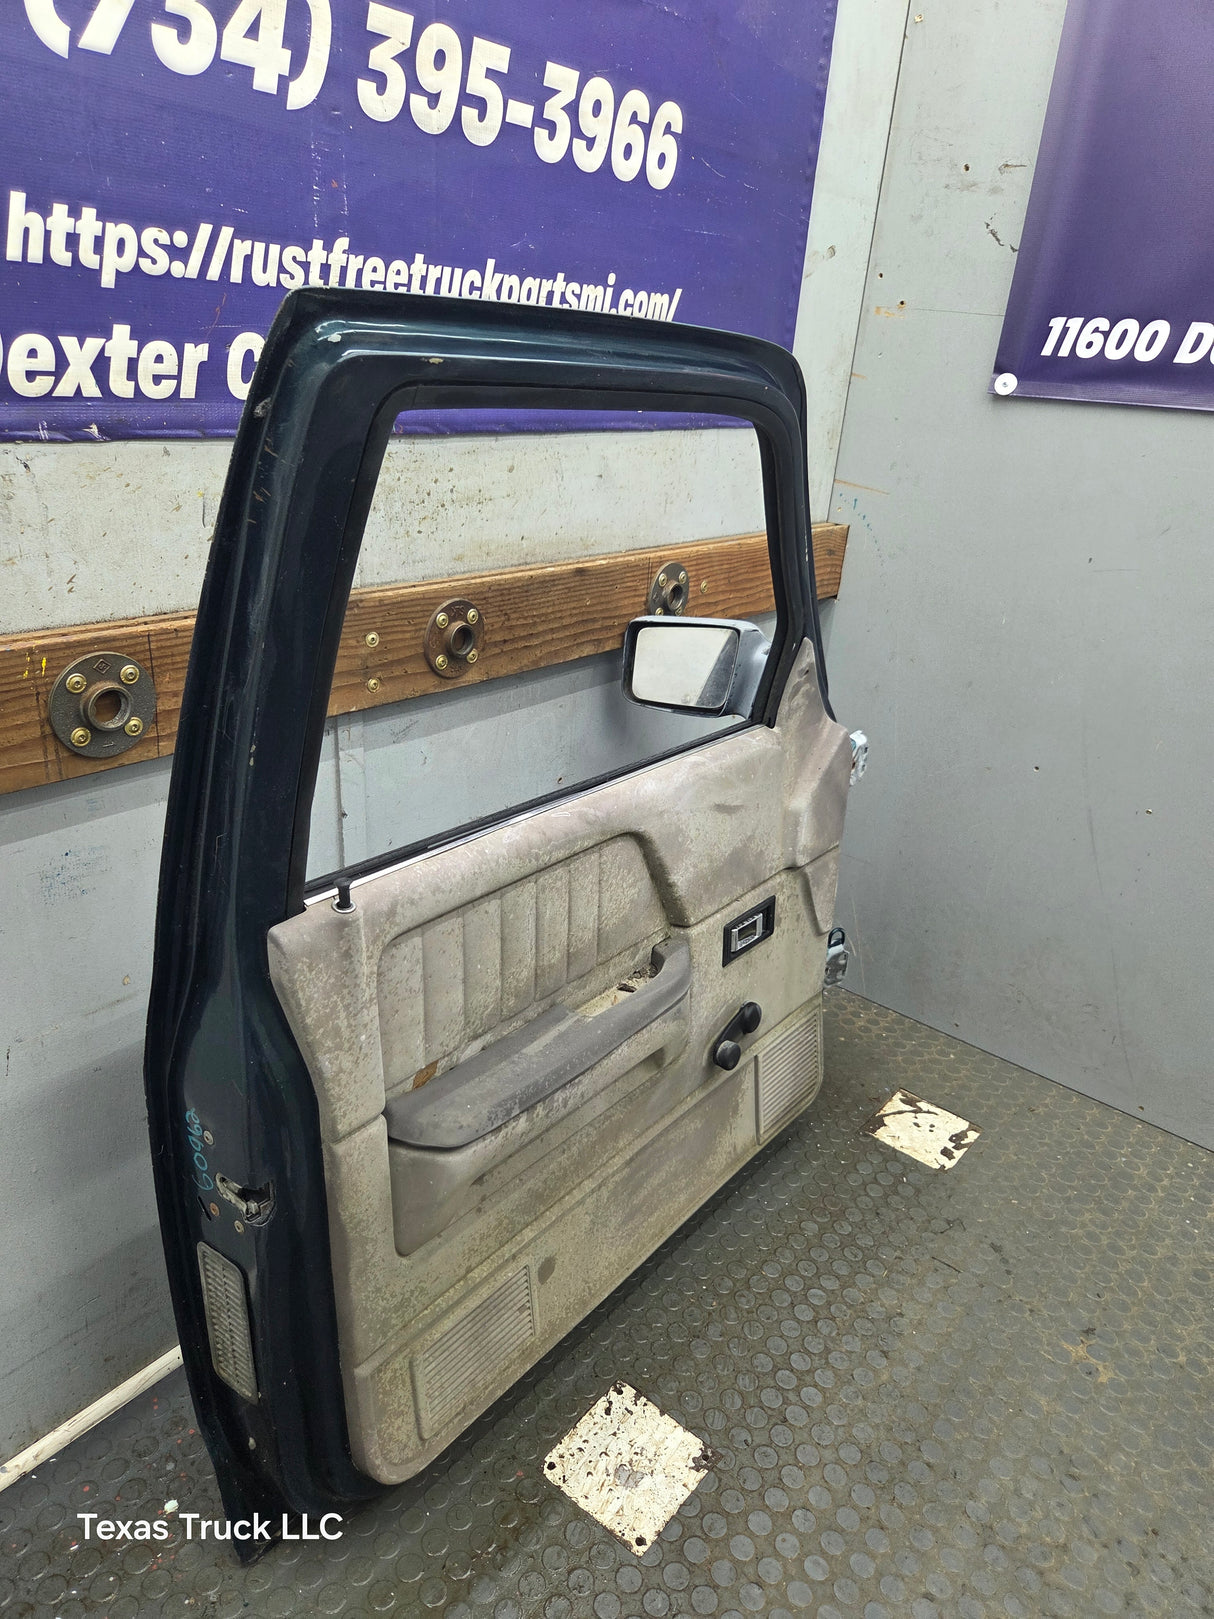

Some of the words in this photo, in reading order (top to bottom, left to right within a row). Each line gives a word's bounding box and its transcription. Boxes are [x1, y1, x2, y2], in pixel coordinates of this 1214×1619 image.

[357, 1, 683, 190] 395-3966
[0, 323, 209, 400] exter
[1040, 316, 1171, 362] 11600
[1173, 321, 1214, 365] D
